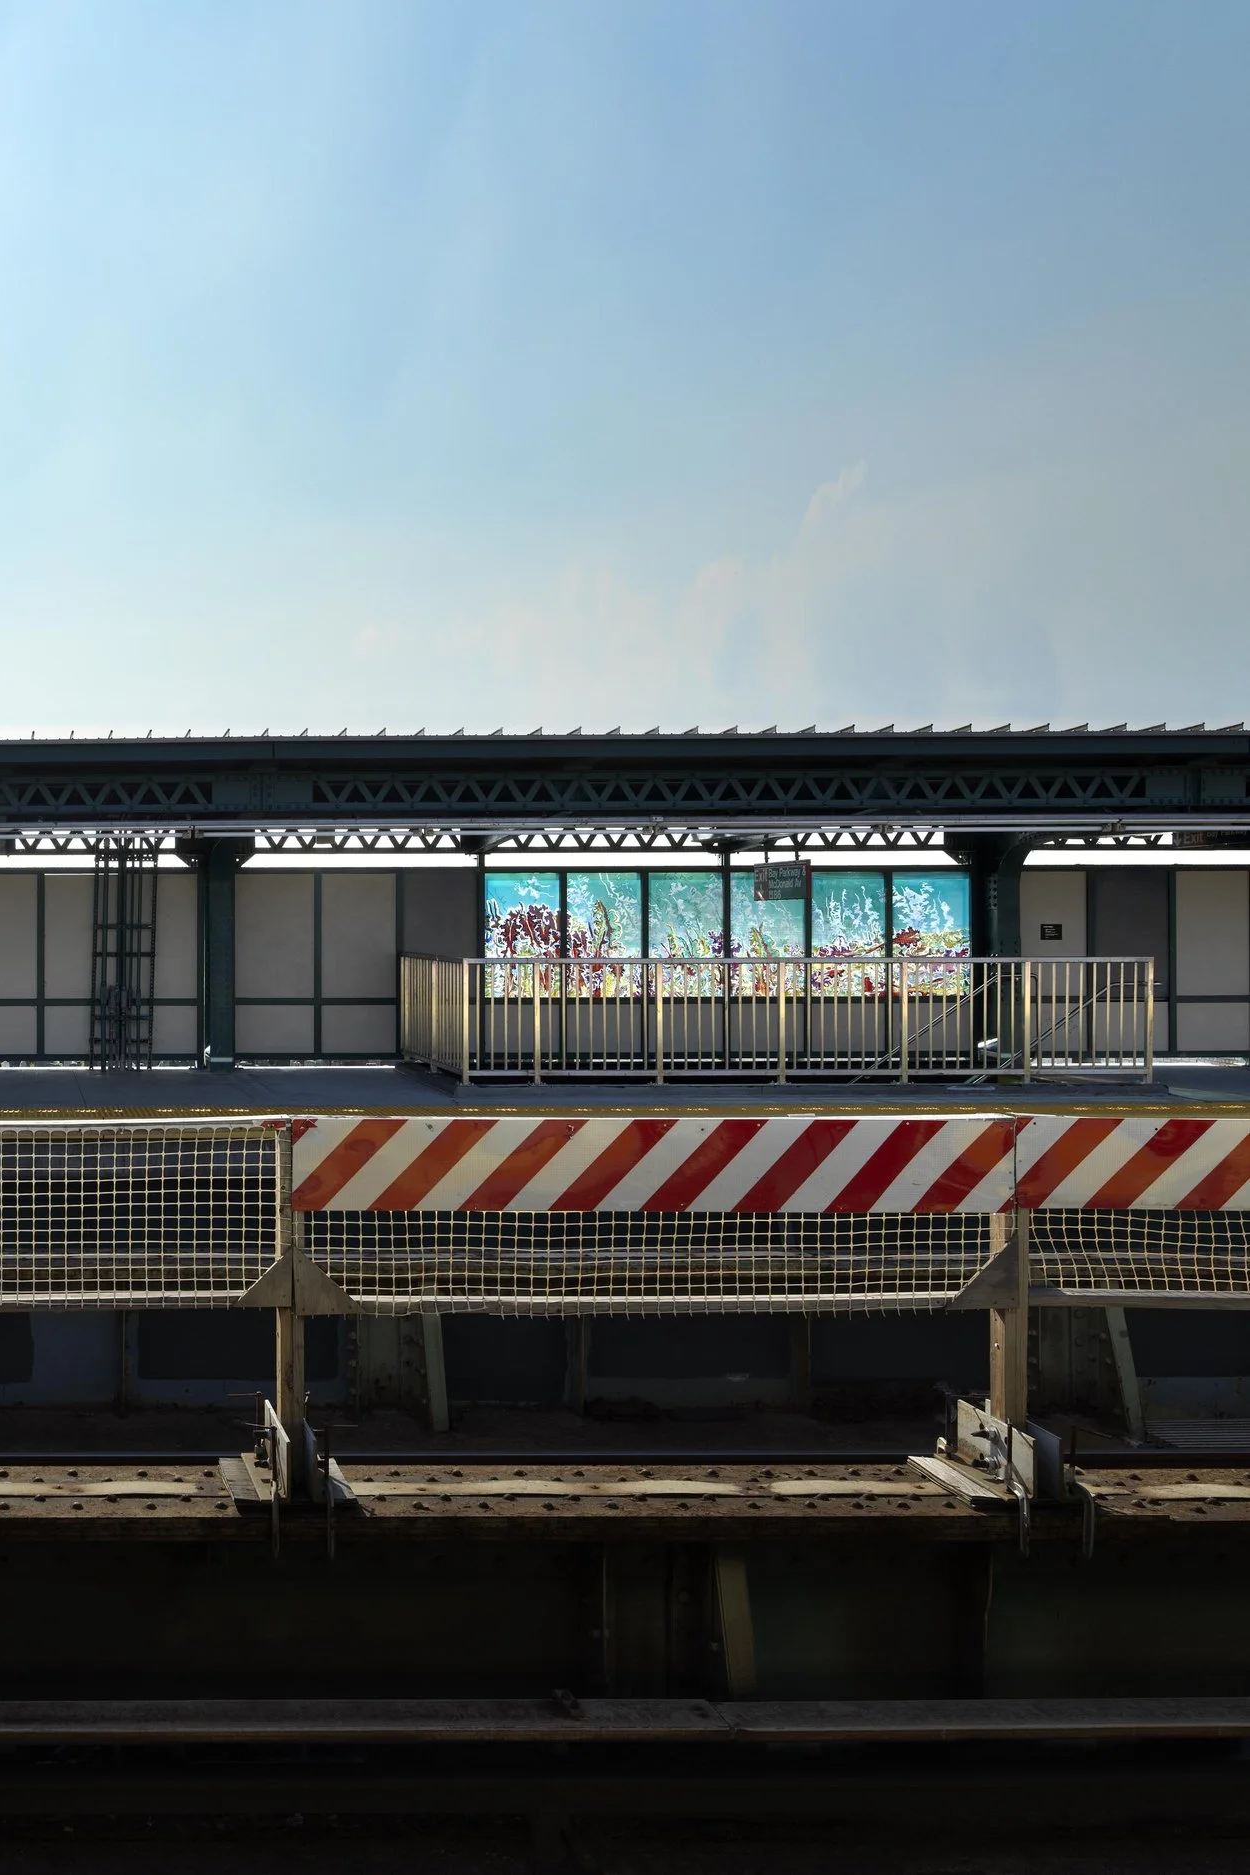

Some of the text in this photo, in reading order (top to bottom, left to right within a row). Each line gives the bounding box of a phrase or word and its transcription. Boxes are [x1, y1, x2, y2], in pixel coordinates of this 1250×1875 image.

[1183, 832, 1204, 844] Exit
[769, 869, 778, 879] Bay
[779, 867, 801, 878] Parkway
[769, 877, 802, 889] McDonald Av
